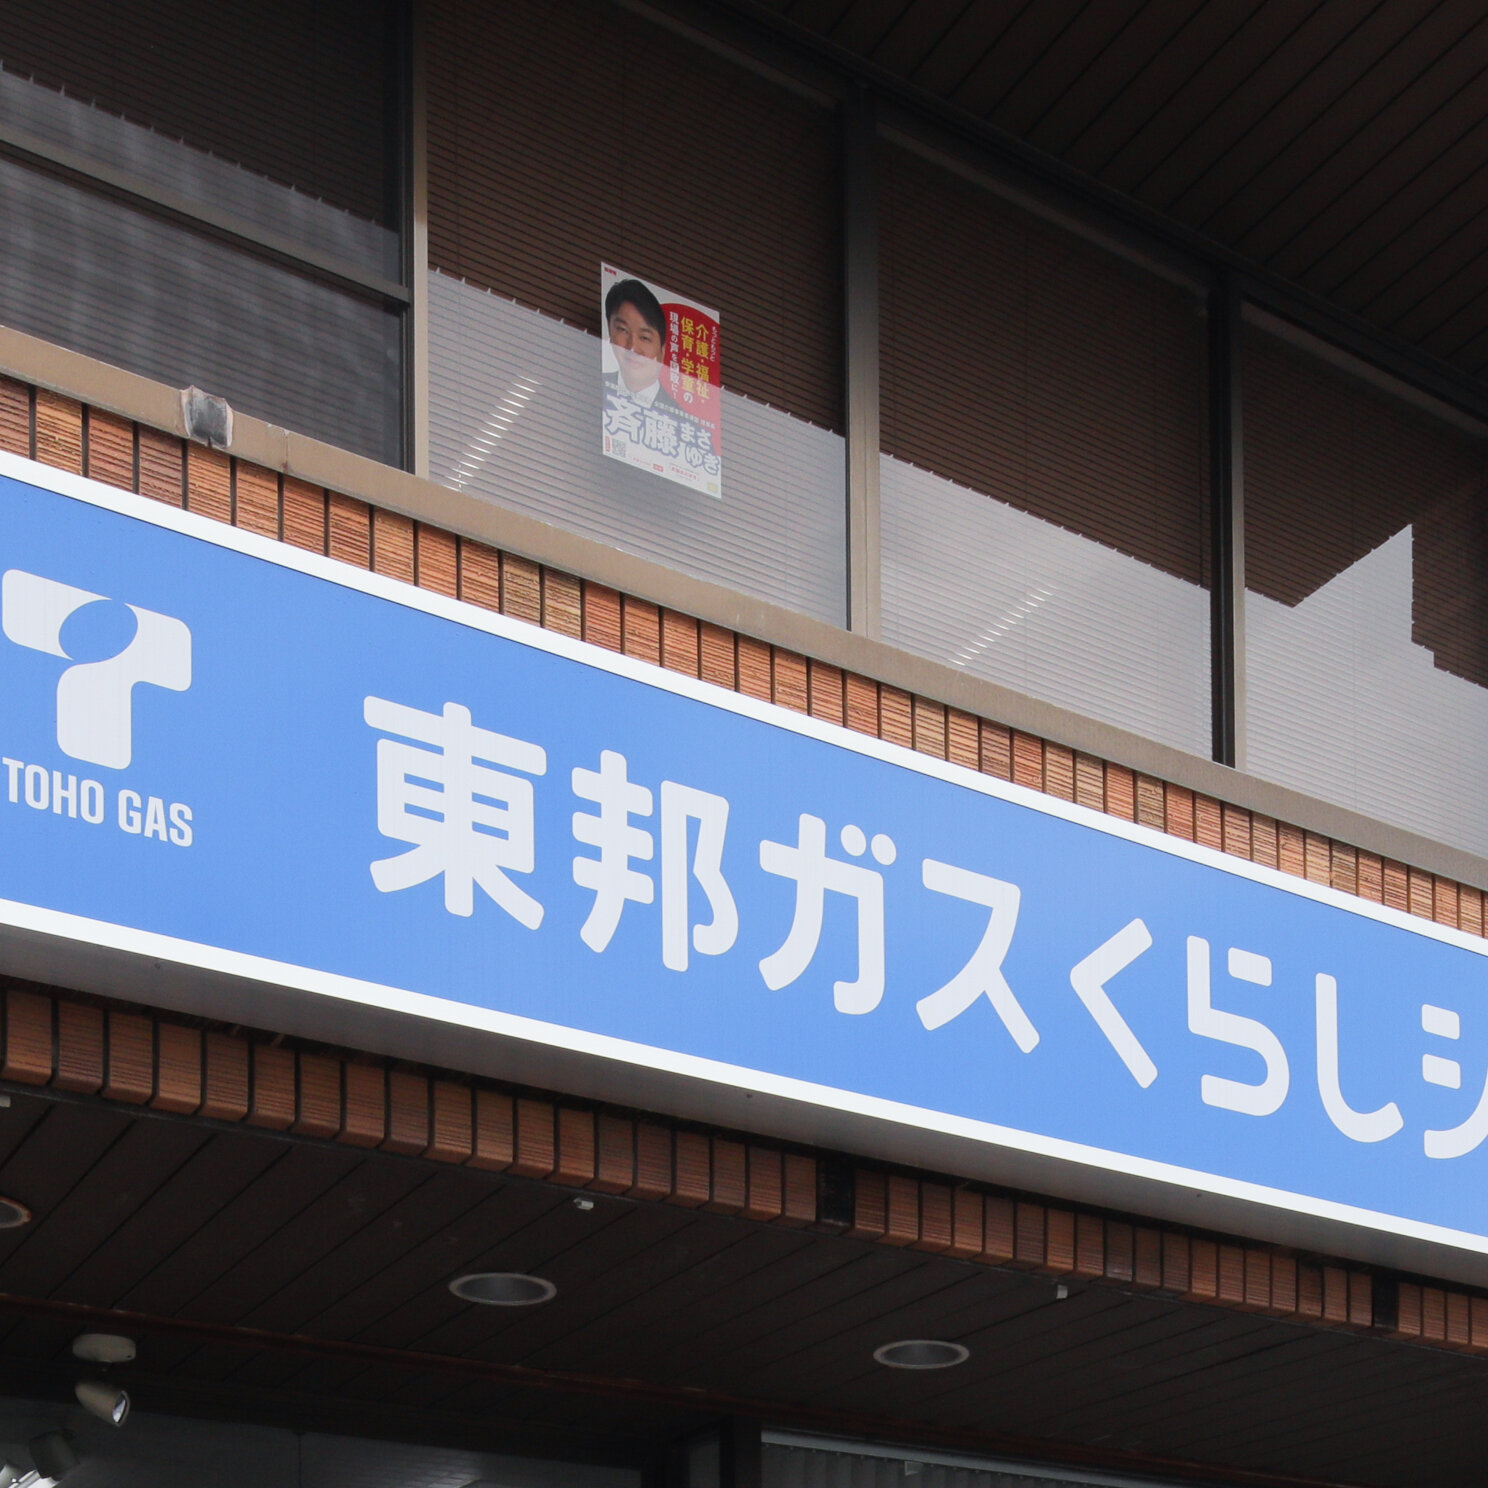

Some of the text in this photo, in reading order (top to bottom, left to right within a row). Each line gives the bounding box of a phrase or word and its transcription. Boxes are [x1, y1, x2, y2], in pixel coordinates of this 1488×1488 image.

[680, 317, 695, 404] 保育・学童の
[2, 758, 193, 848] TOHO GAS
